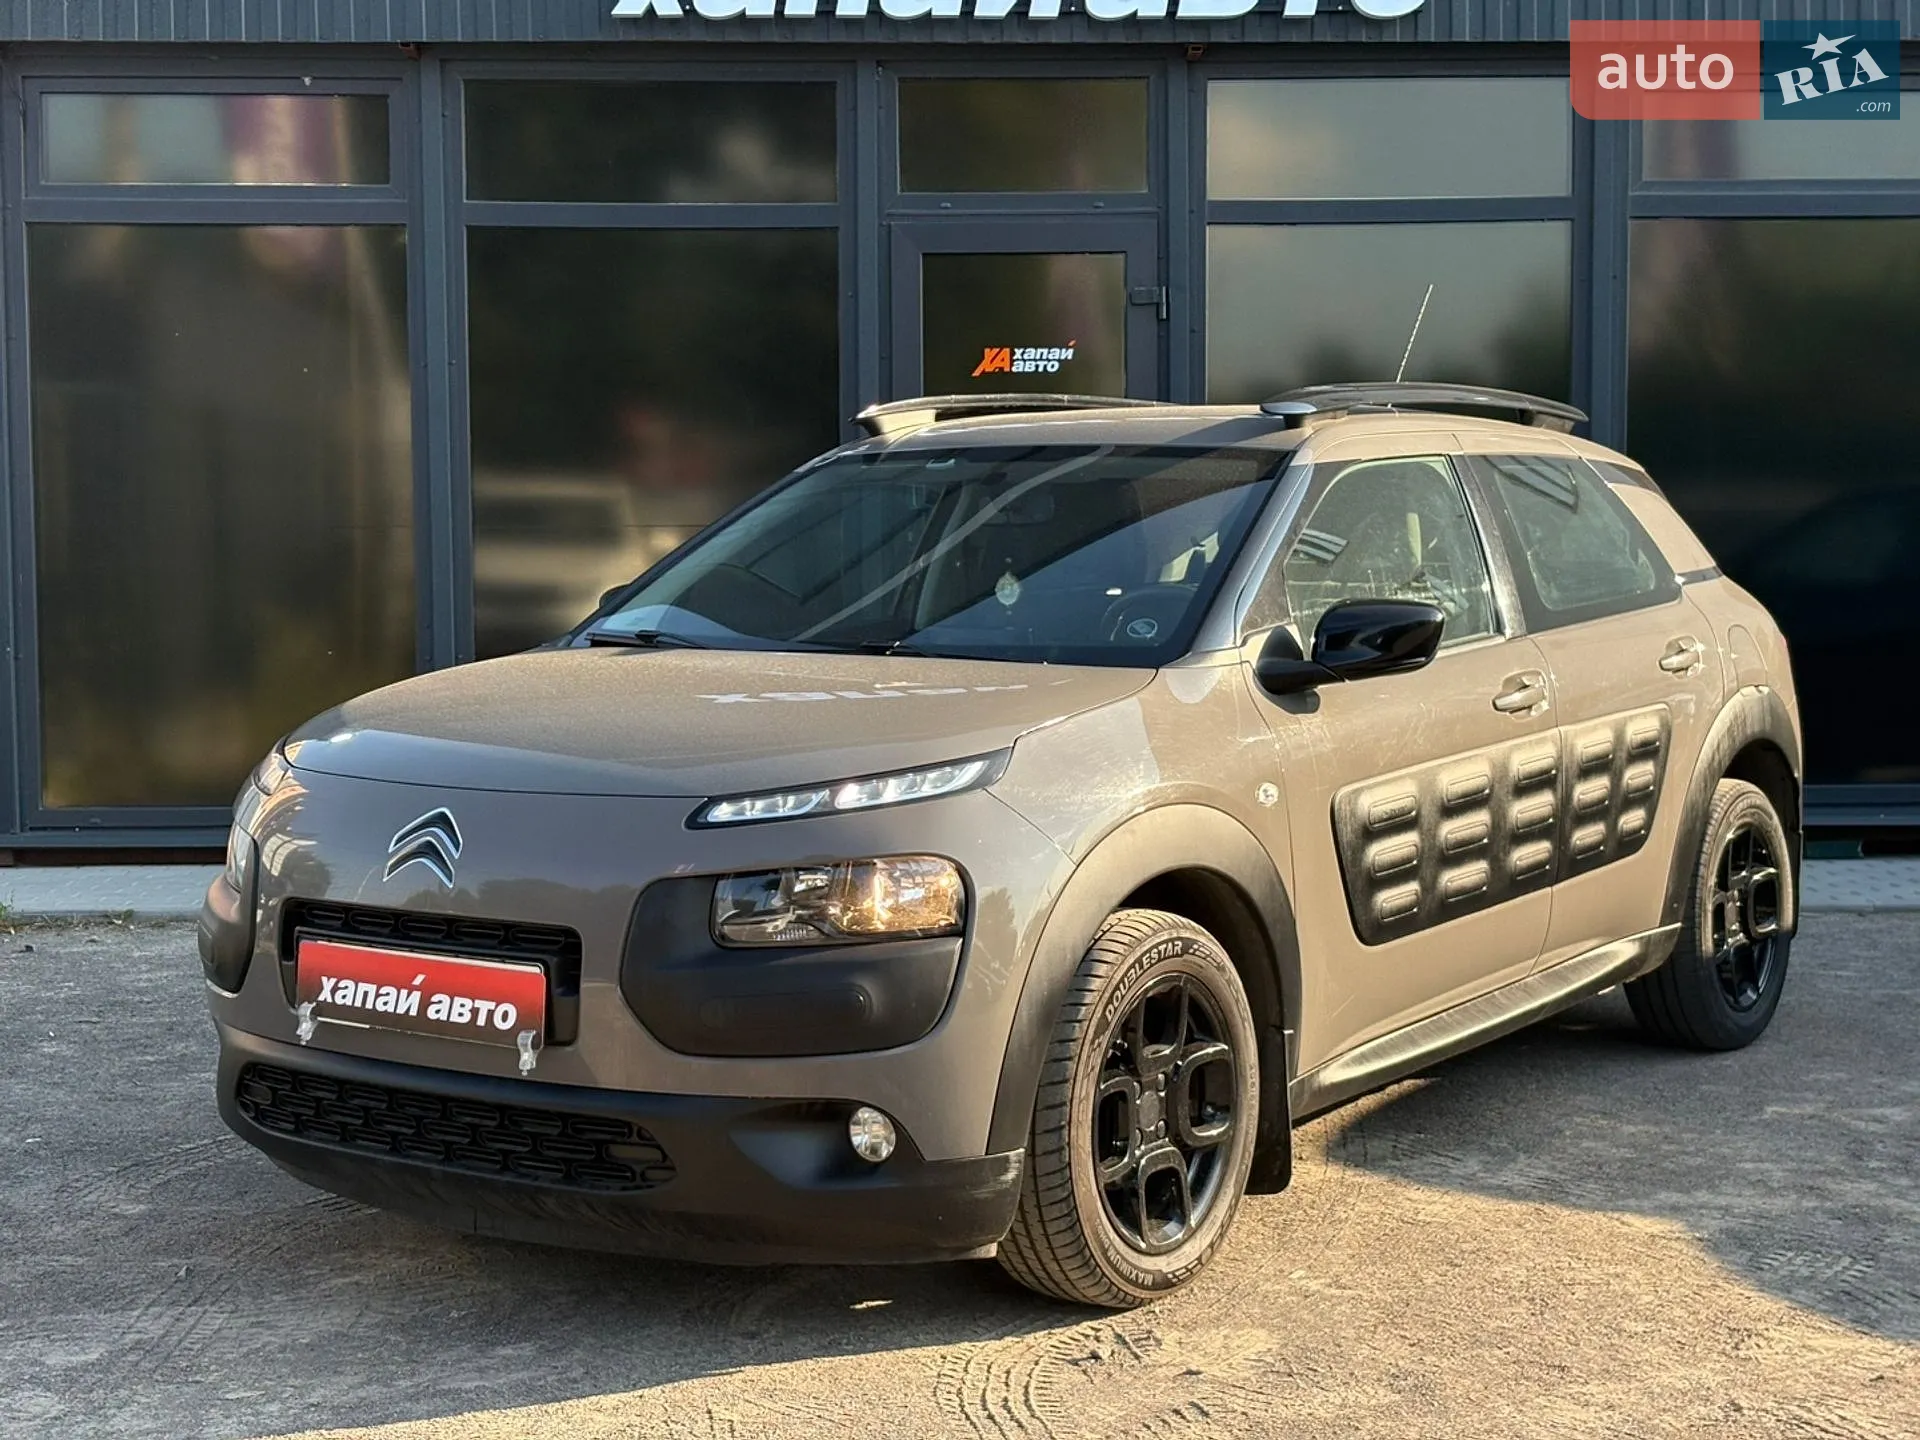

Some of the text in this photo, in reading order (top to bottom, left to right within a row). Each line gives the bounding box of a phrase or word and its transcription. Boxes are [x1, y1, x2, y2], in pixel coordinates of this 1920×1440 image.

[1011, 359, 1060, 373] авто
[1104, 940, 1183, 1023] DOUBLESTAR
[426, 992, 518, 1031] авто
